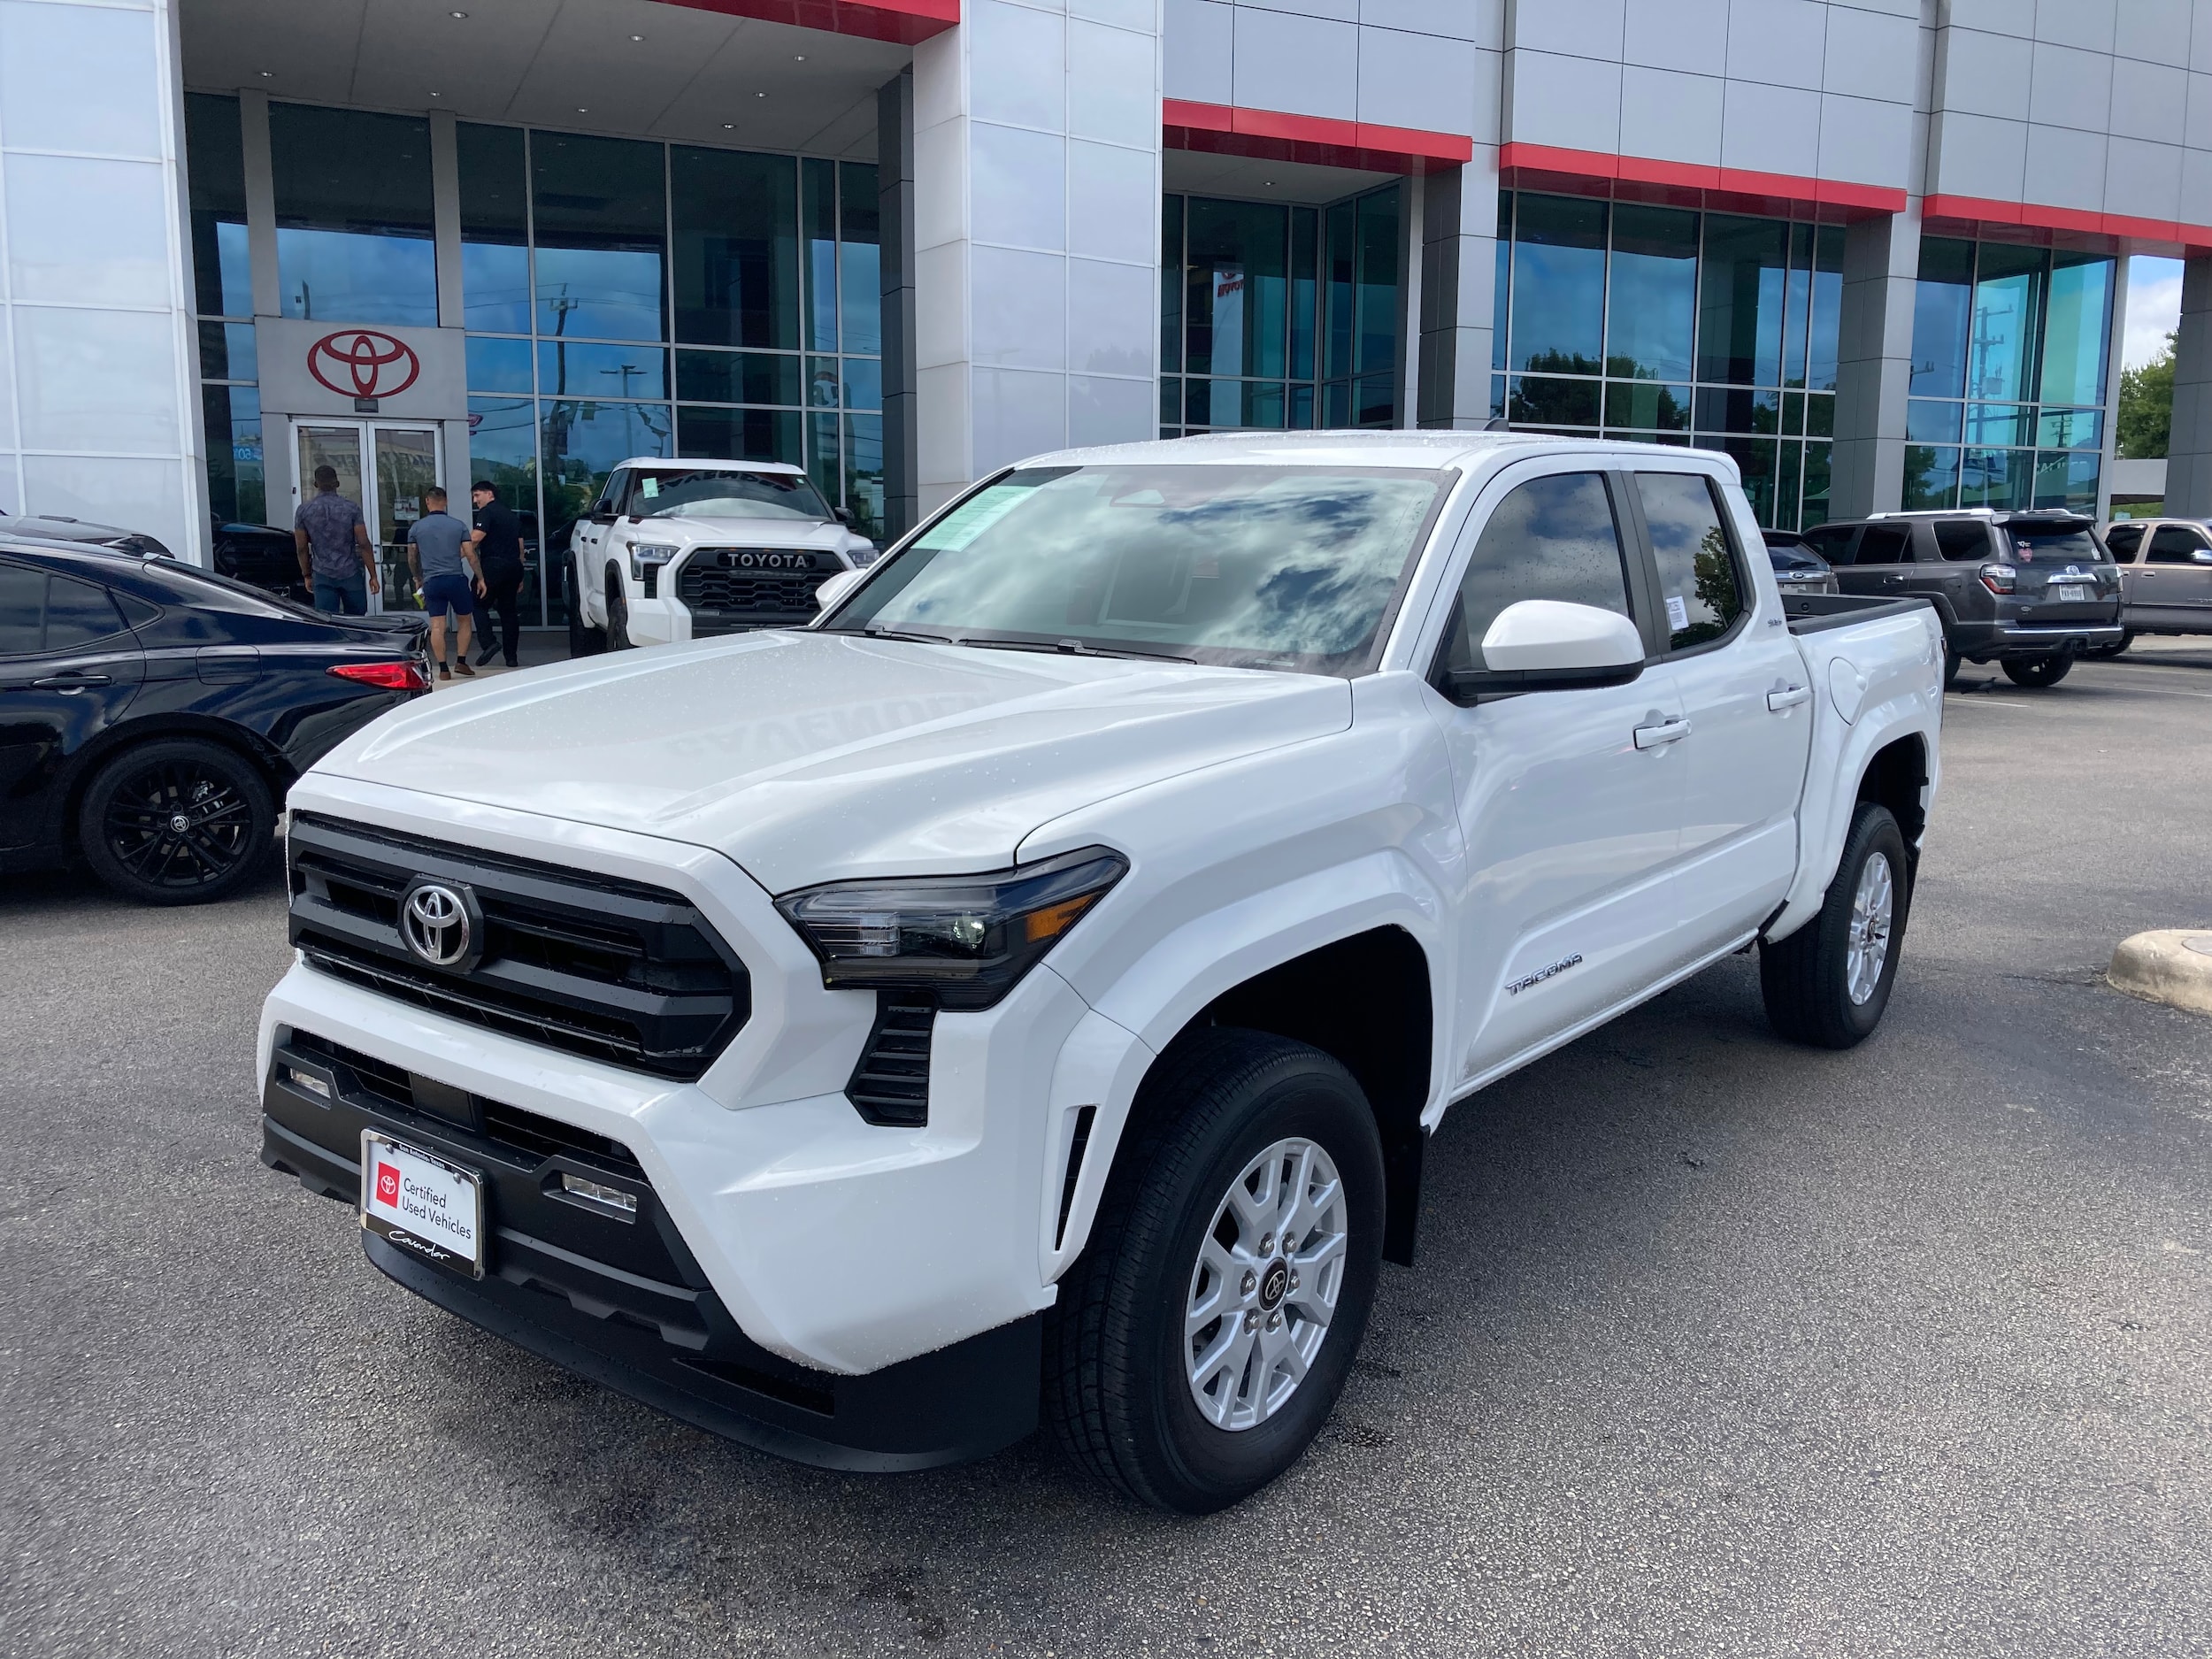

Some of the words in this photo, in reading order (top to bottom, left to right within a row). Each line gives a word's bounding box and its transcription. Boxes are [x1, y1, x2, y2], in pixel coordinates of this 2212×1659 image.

[727, 553, 808, 568] TOYOTA
[1504, 951, 1583, 996] TACOMA
[403, 1178, 447, 1209] Certified
[402, 1196, 426, 1219] Used
[428, 1208, 472, 1240] Vehicles
